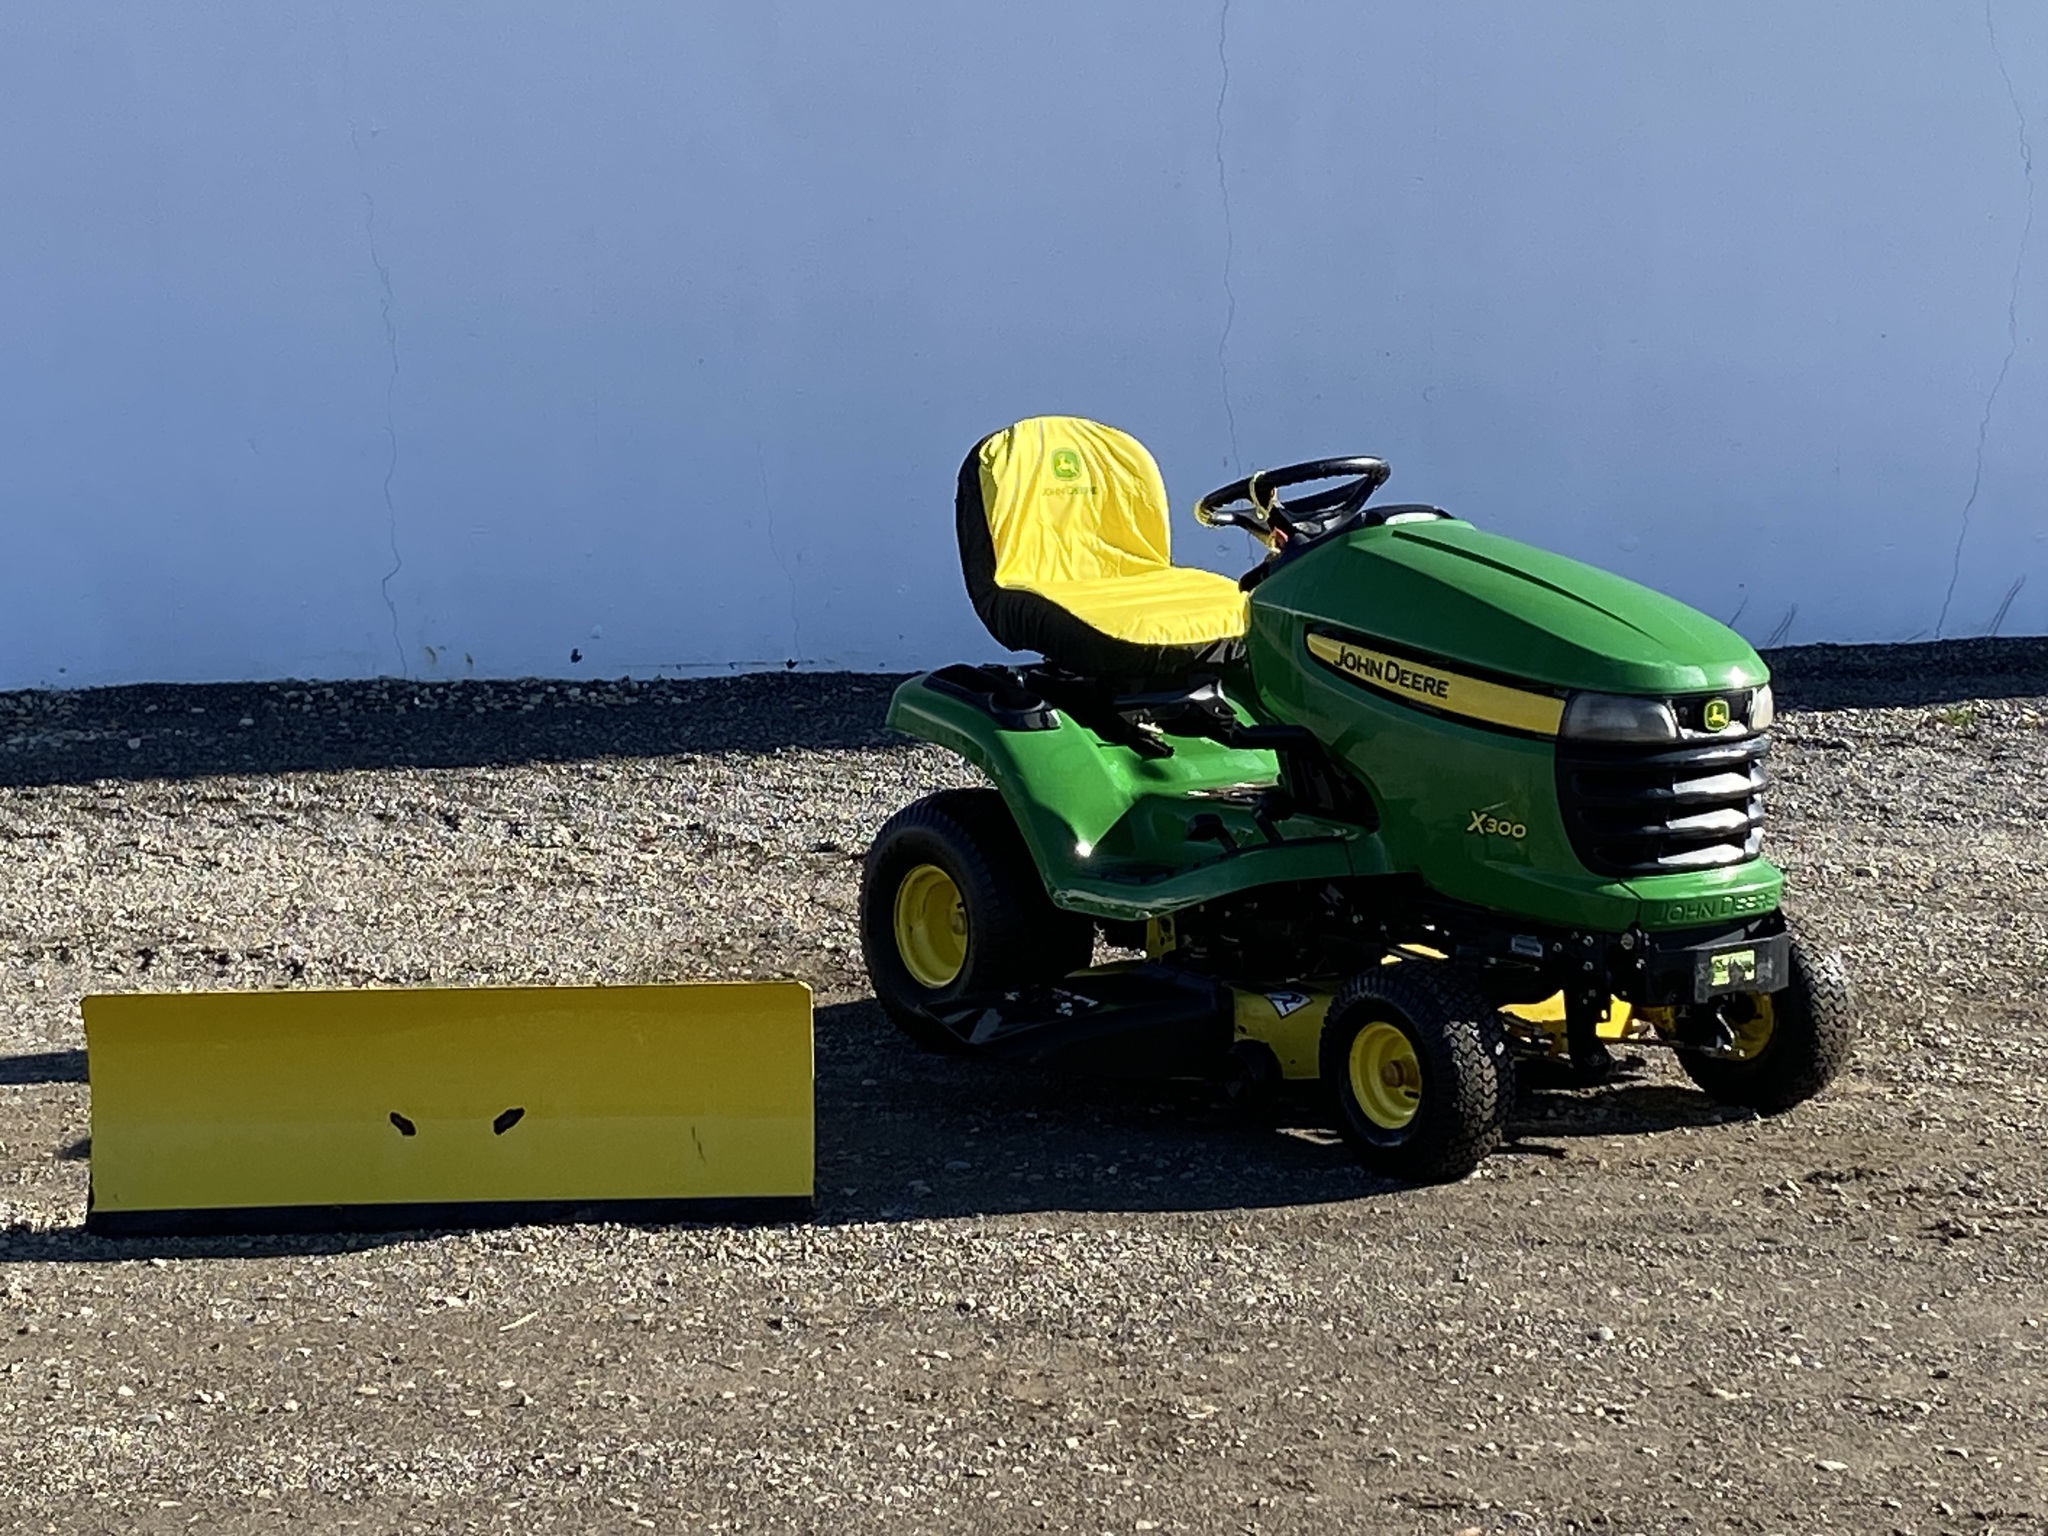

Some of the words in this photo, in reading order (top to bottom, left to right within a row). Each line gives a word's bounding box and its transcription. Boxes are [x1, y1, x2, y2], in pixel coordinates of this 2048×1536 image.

[1333, 645, 1384, 681] JOHN
[1384, 660, 1450, 699] DEERE
[1466, 810, 1527, 838] X300
[1656, 900, 1716, 924] JOHN
